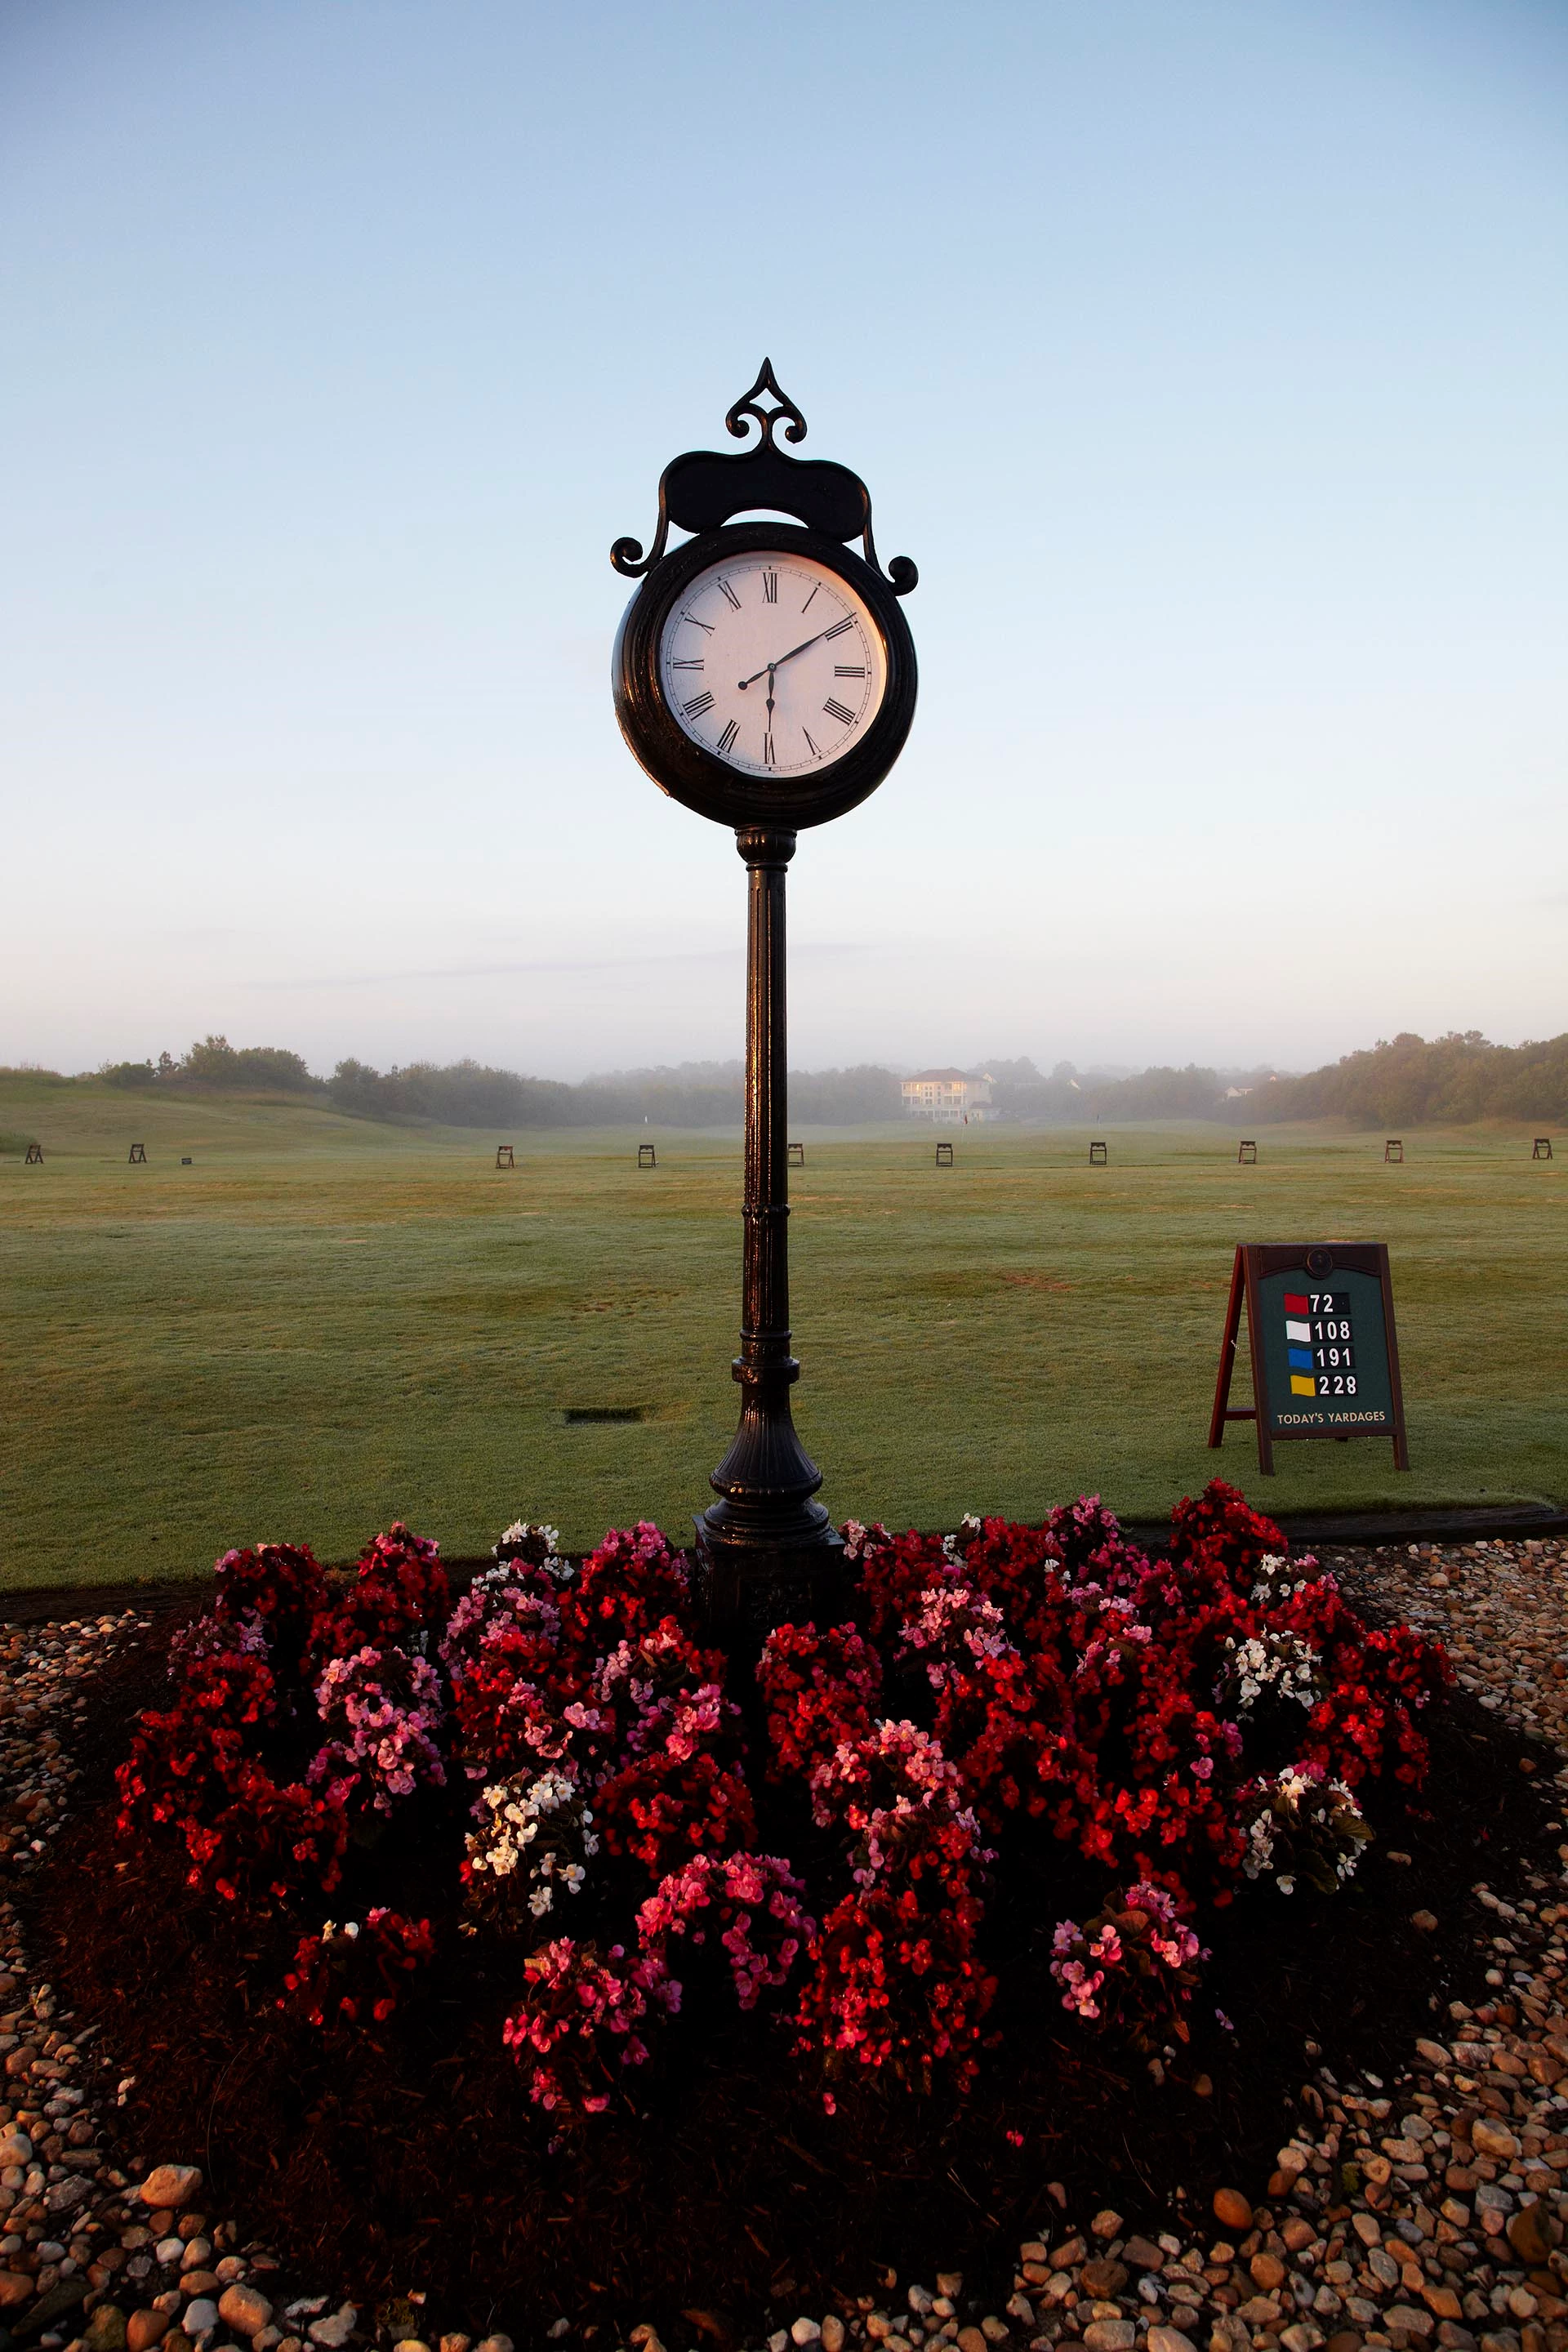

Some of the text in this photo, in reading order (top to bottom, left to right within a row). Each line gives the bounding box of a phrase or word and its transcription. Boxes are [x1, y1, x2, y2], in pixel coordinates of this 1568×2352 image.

[717, 581, 742, 613] XI
[761, 572, 778, 604] XII
[801, 586, 818, 614] I
[684, 612, 716, 637] X
[823, 619, 856, 642] II
[672, 657, 705, 671] IX
[834, 665, 866, 679] III
[682, 691, 717, 721] VIII
[822, 697, 857, 727] IIII
[715, 719, 741, 754] VII
[764, 733, 776, 764] VI
[802, 725, 822, 756] V
[1310, 1294, 1334, 1312] 72
[1315, 1321, 1350, 1340] 108
[1316, 1348, 1351, 1367] 191
[1319, 1375, 1356, 1395] 228
[1277, 1411, 1386, 1424] TODAY'S YARDAGES
